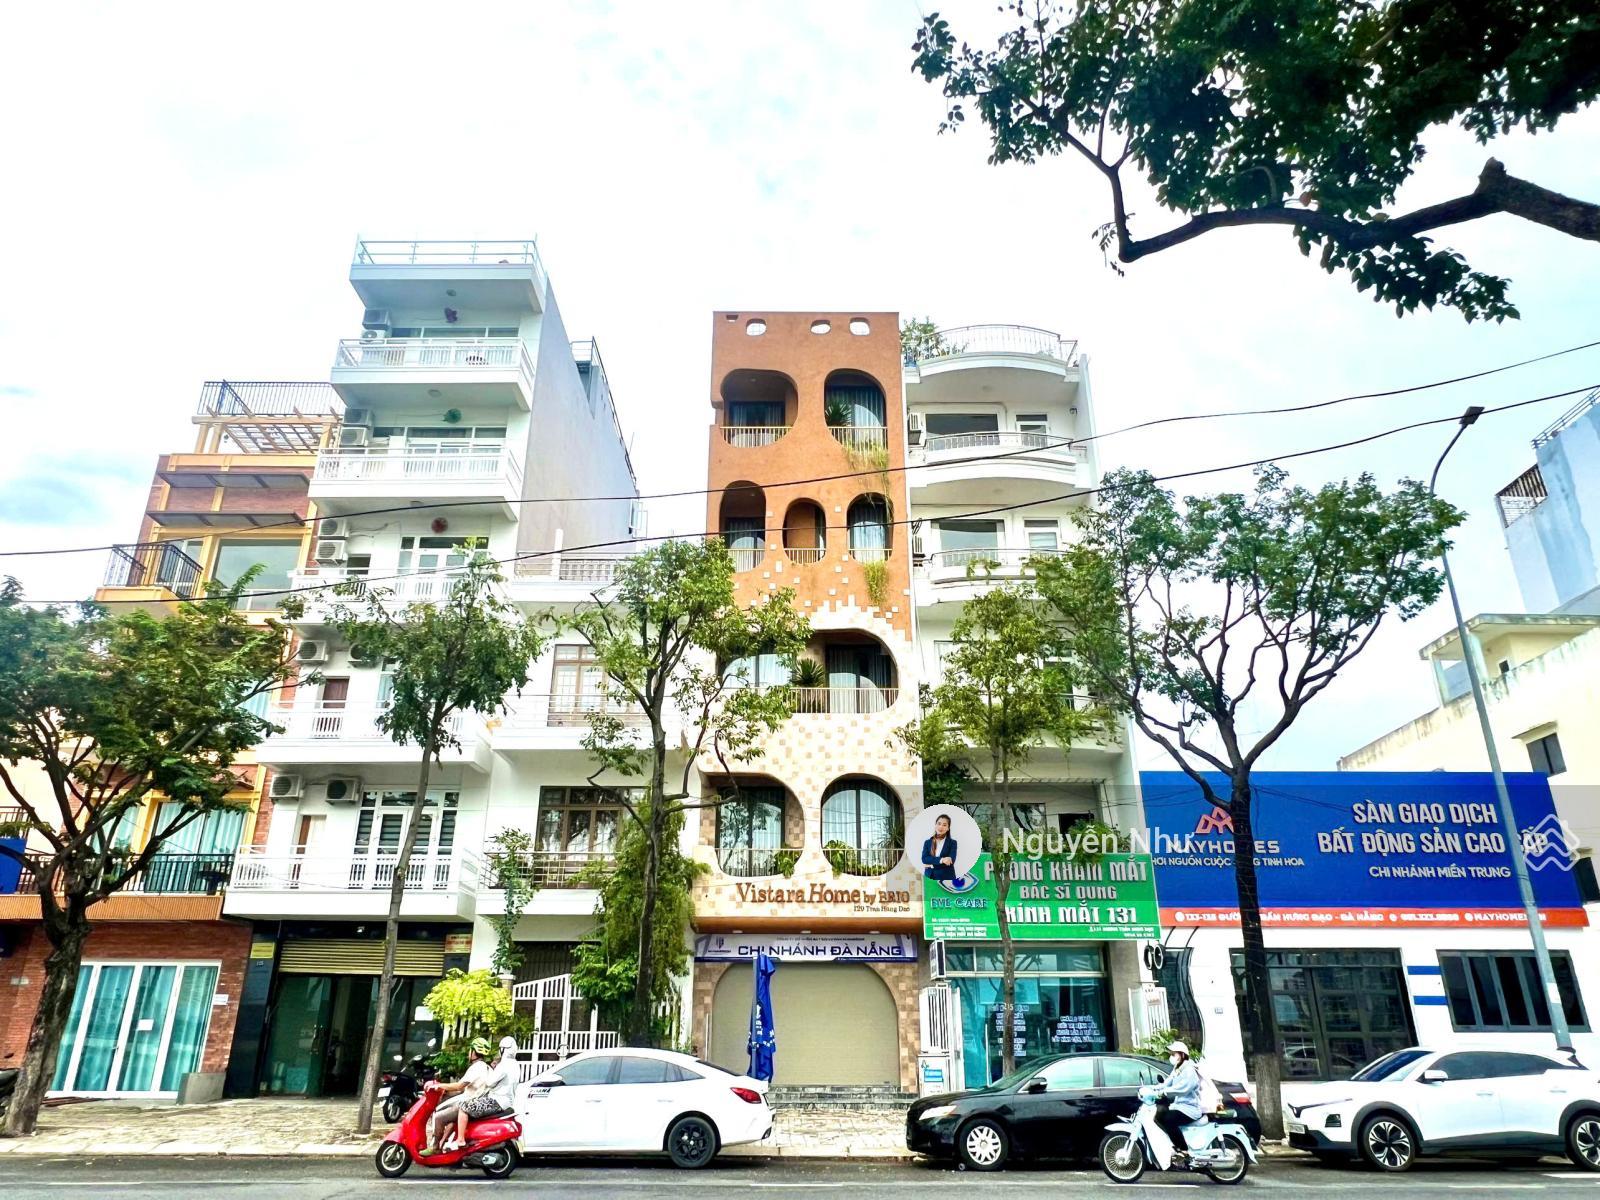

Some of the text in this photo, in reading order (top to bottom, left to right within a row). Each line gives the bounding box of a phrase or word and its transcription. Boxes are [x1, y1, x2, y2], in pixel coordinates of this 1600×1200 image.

[1352, 799, 1498, 827] SÀN GIAO DỊCH
[1166, 840, 1280, 854] MAYHOES
[1317, 827, 1355, 853] BẤT
[1361, 829, 1416, 857] ĐỘNG
[1420, 826, 1463, 853] SẢN
[1464, 832, 1506, 853] CAO
[1109, 855, 1148, 881] MẮT
[1284, 858, 1304, 866] HOA
[1369, 866, 1391, 878] CHI
[1391, 864, 1436, 878] NHÁNH
[1467, 866, 1511, 878] TRUNG
[736, 882, 806, 904] Vistara
[807, 882, 861, 904] Home
[863, 890, 877, 906] by
[1020, 882, 1050, 899] BÁC
[1054, 883, 1071, 899] SĨ
[1058, 900, 1101, 924] MẮT
[1106, 906, 1137, 924] 131
[768, 942, 827, 956] NHÁNH
[830, 943, 852, 956] ĐÀ
[856, 941, 902, 956] NẴNG
